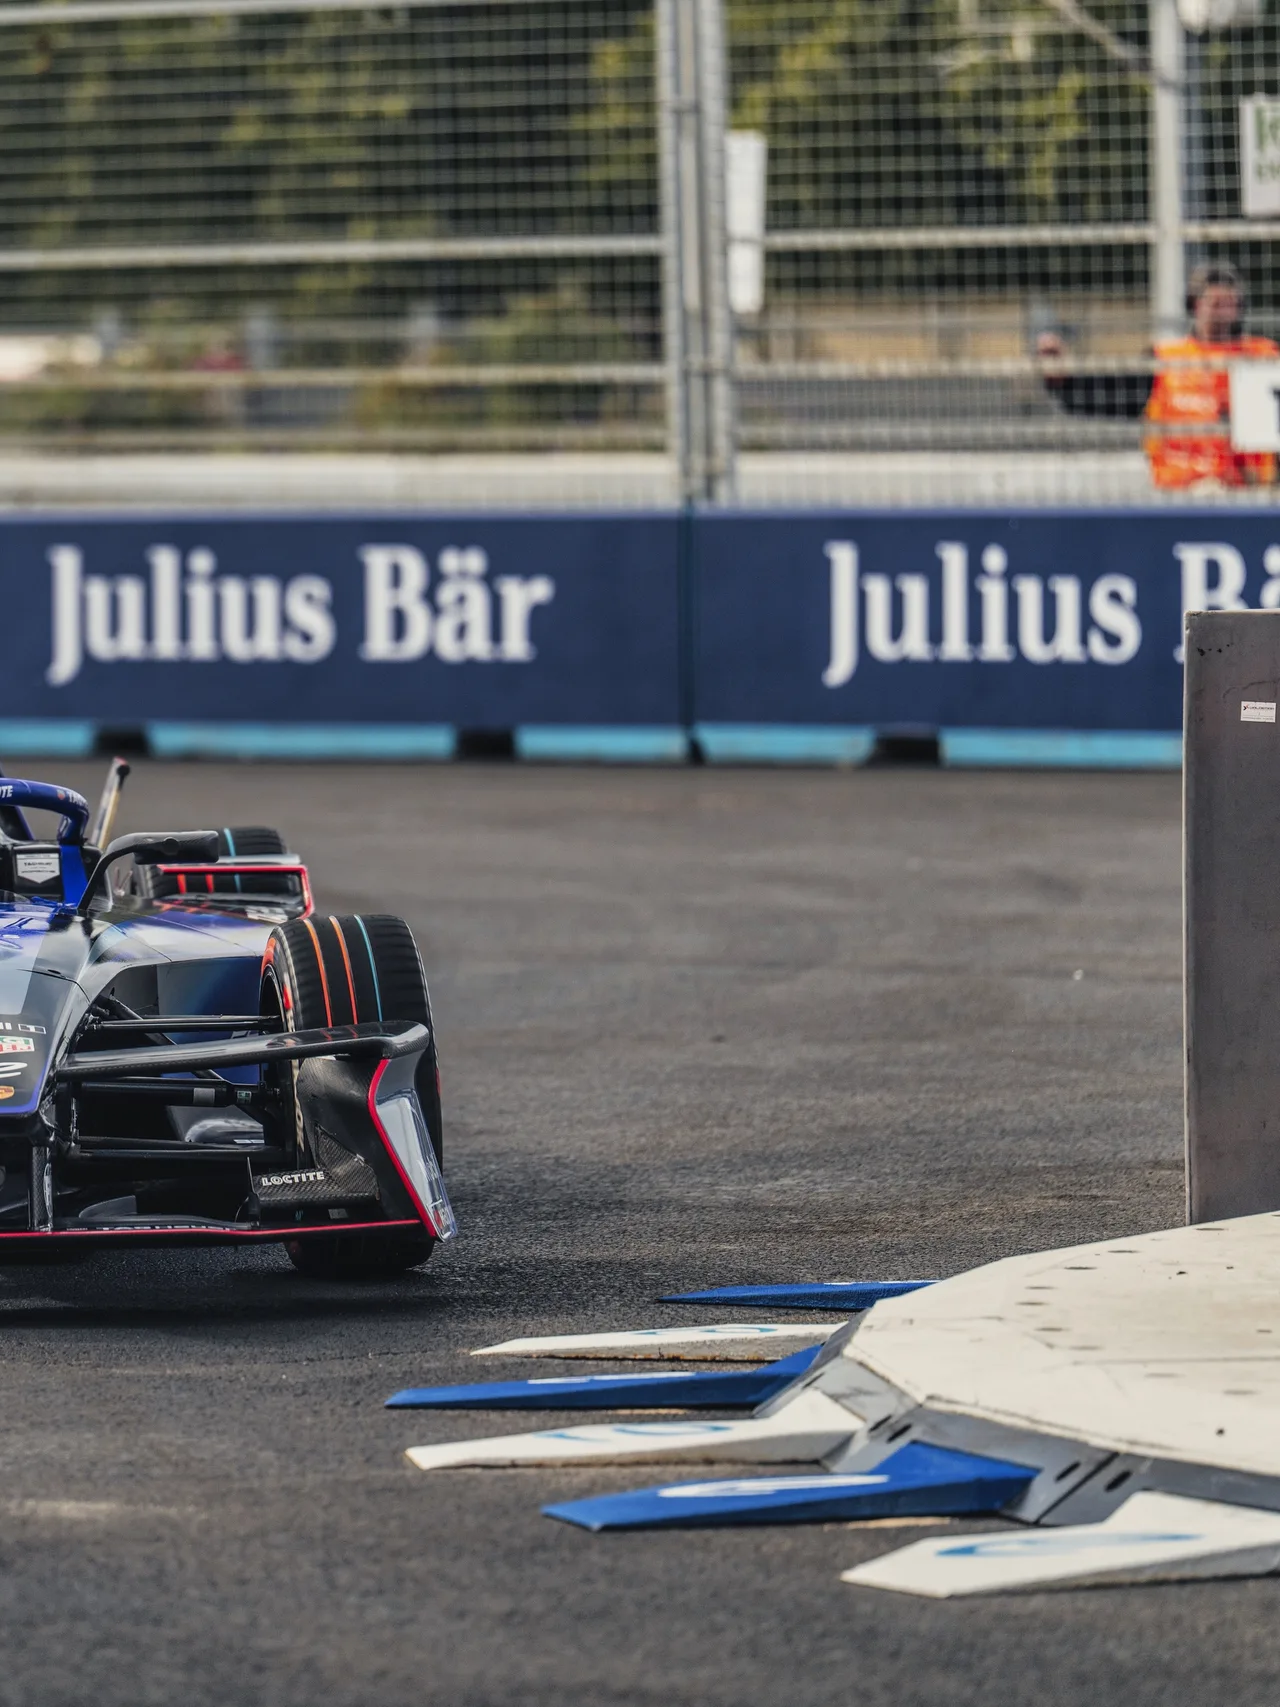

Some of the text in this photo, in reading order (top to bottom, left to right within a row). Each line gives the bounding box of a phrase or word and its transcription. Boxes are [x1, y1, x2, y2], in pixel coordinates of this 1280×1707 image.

[47, 545, 555, 686] Julius Bär
[822, 541, 1143, 687] Julius
[261, 1171, 326, 1187] LOCTITE
